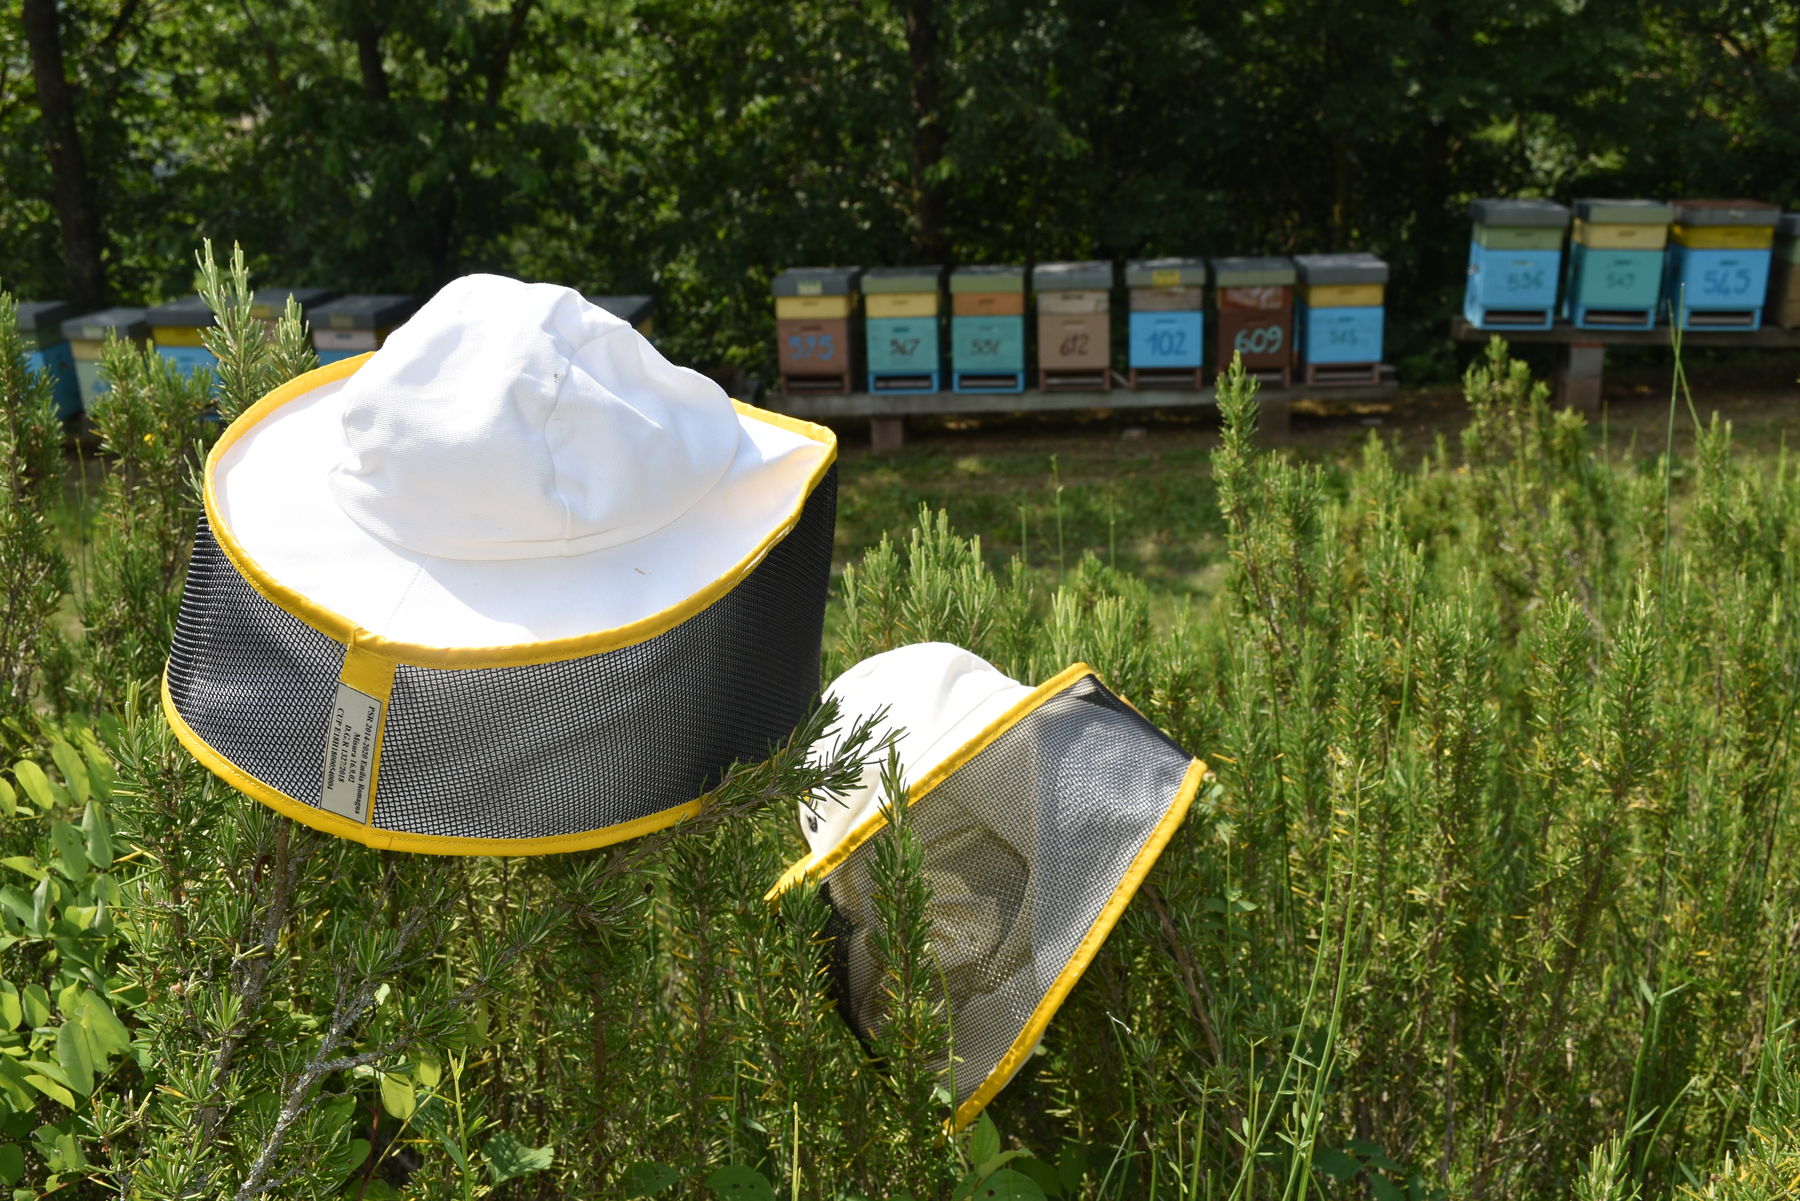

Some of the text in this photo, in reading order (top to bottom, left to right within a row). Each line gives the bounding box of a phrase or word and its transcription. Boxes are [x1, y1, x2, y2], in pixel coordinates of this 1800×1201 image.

[1145, 330, 1188, 356] 102
[1234, 325, 1284, 354] 609
[335, 708, 344, 727] CUP
[352, 733, 361, 758] Misura
[355, 705, 376, 814] PSR 2014-2020 Emilia Romagna
